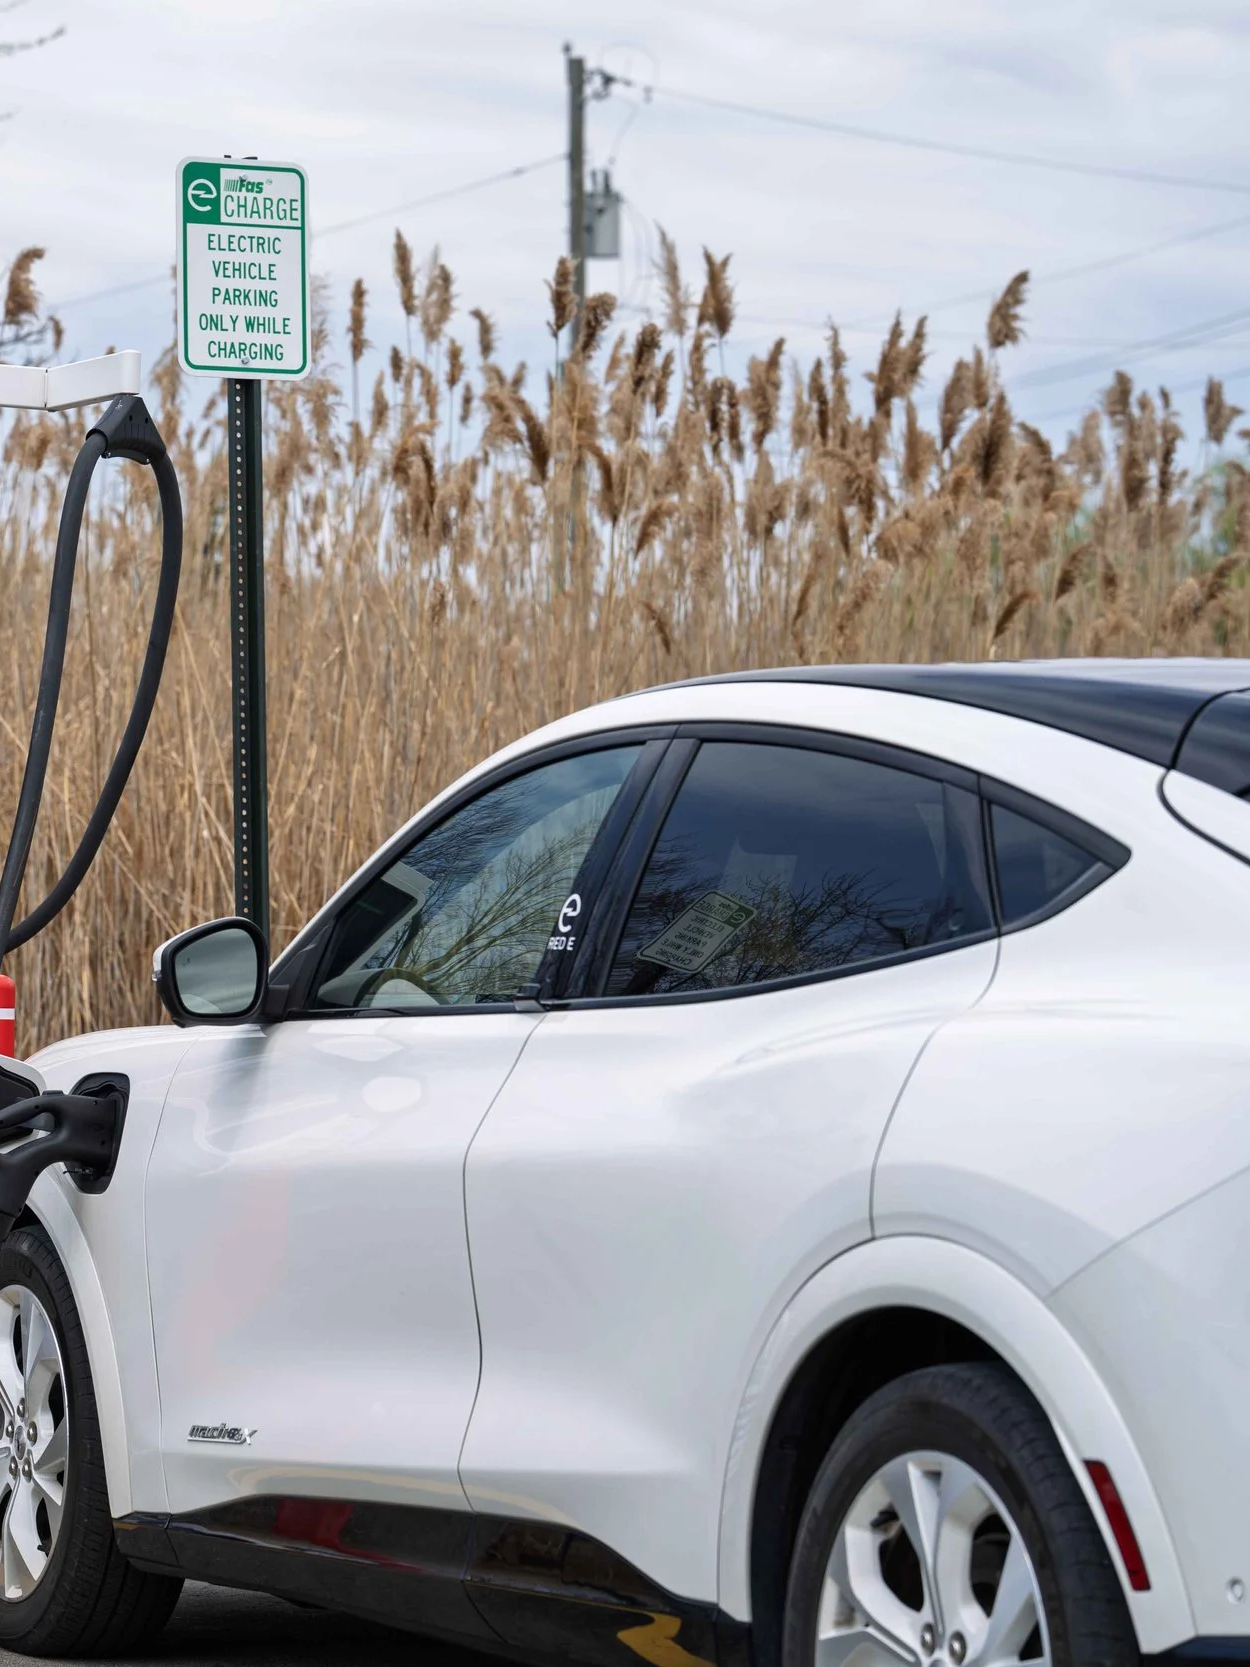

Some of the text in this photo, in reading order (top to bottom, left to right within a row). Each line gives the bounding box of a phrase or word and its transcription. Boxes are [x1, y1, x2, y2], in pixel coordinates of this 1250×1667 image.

[224, 194, 299, 221] CHARGE
[207, 233, 281, 255] ELECTRIC
[212, 260, 277, 281] VEHICLE
[212, 287, 278, 308] PARKING
[199, 313, 291, 335] ONLY WHILE
[208, 340, 284, 361] CHARGING
[547, 936, 576, 951] RED E
